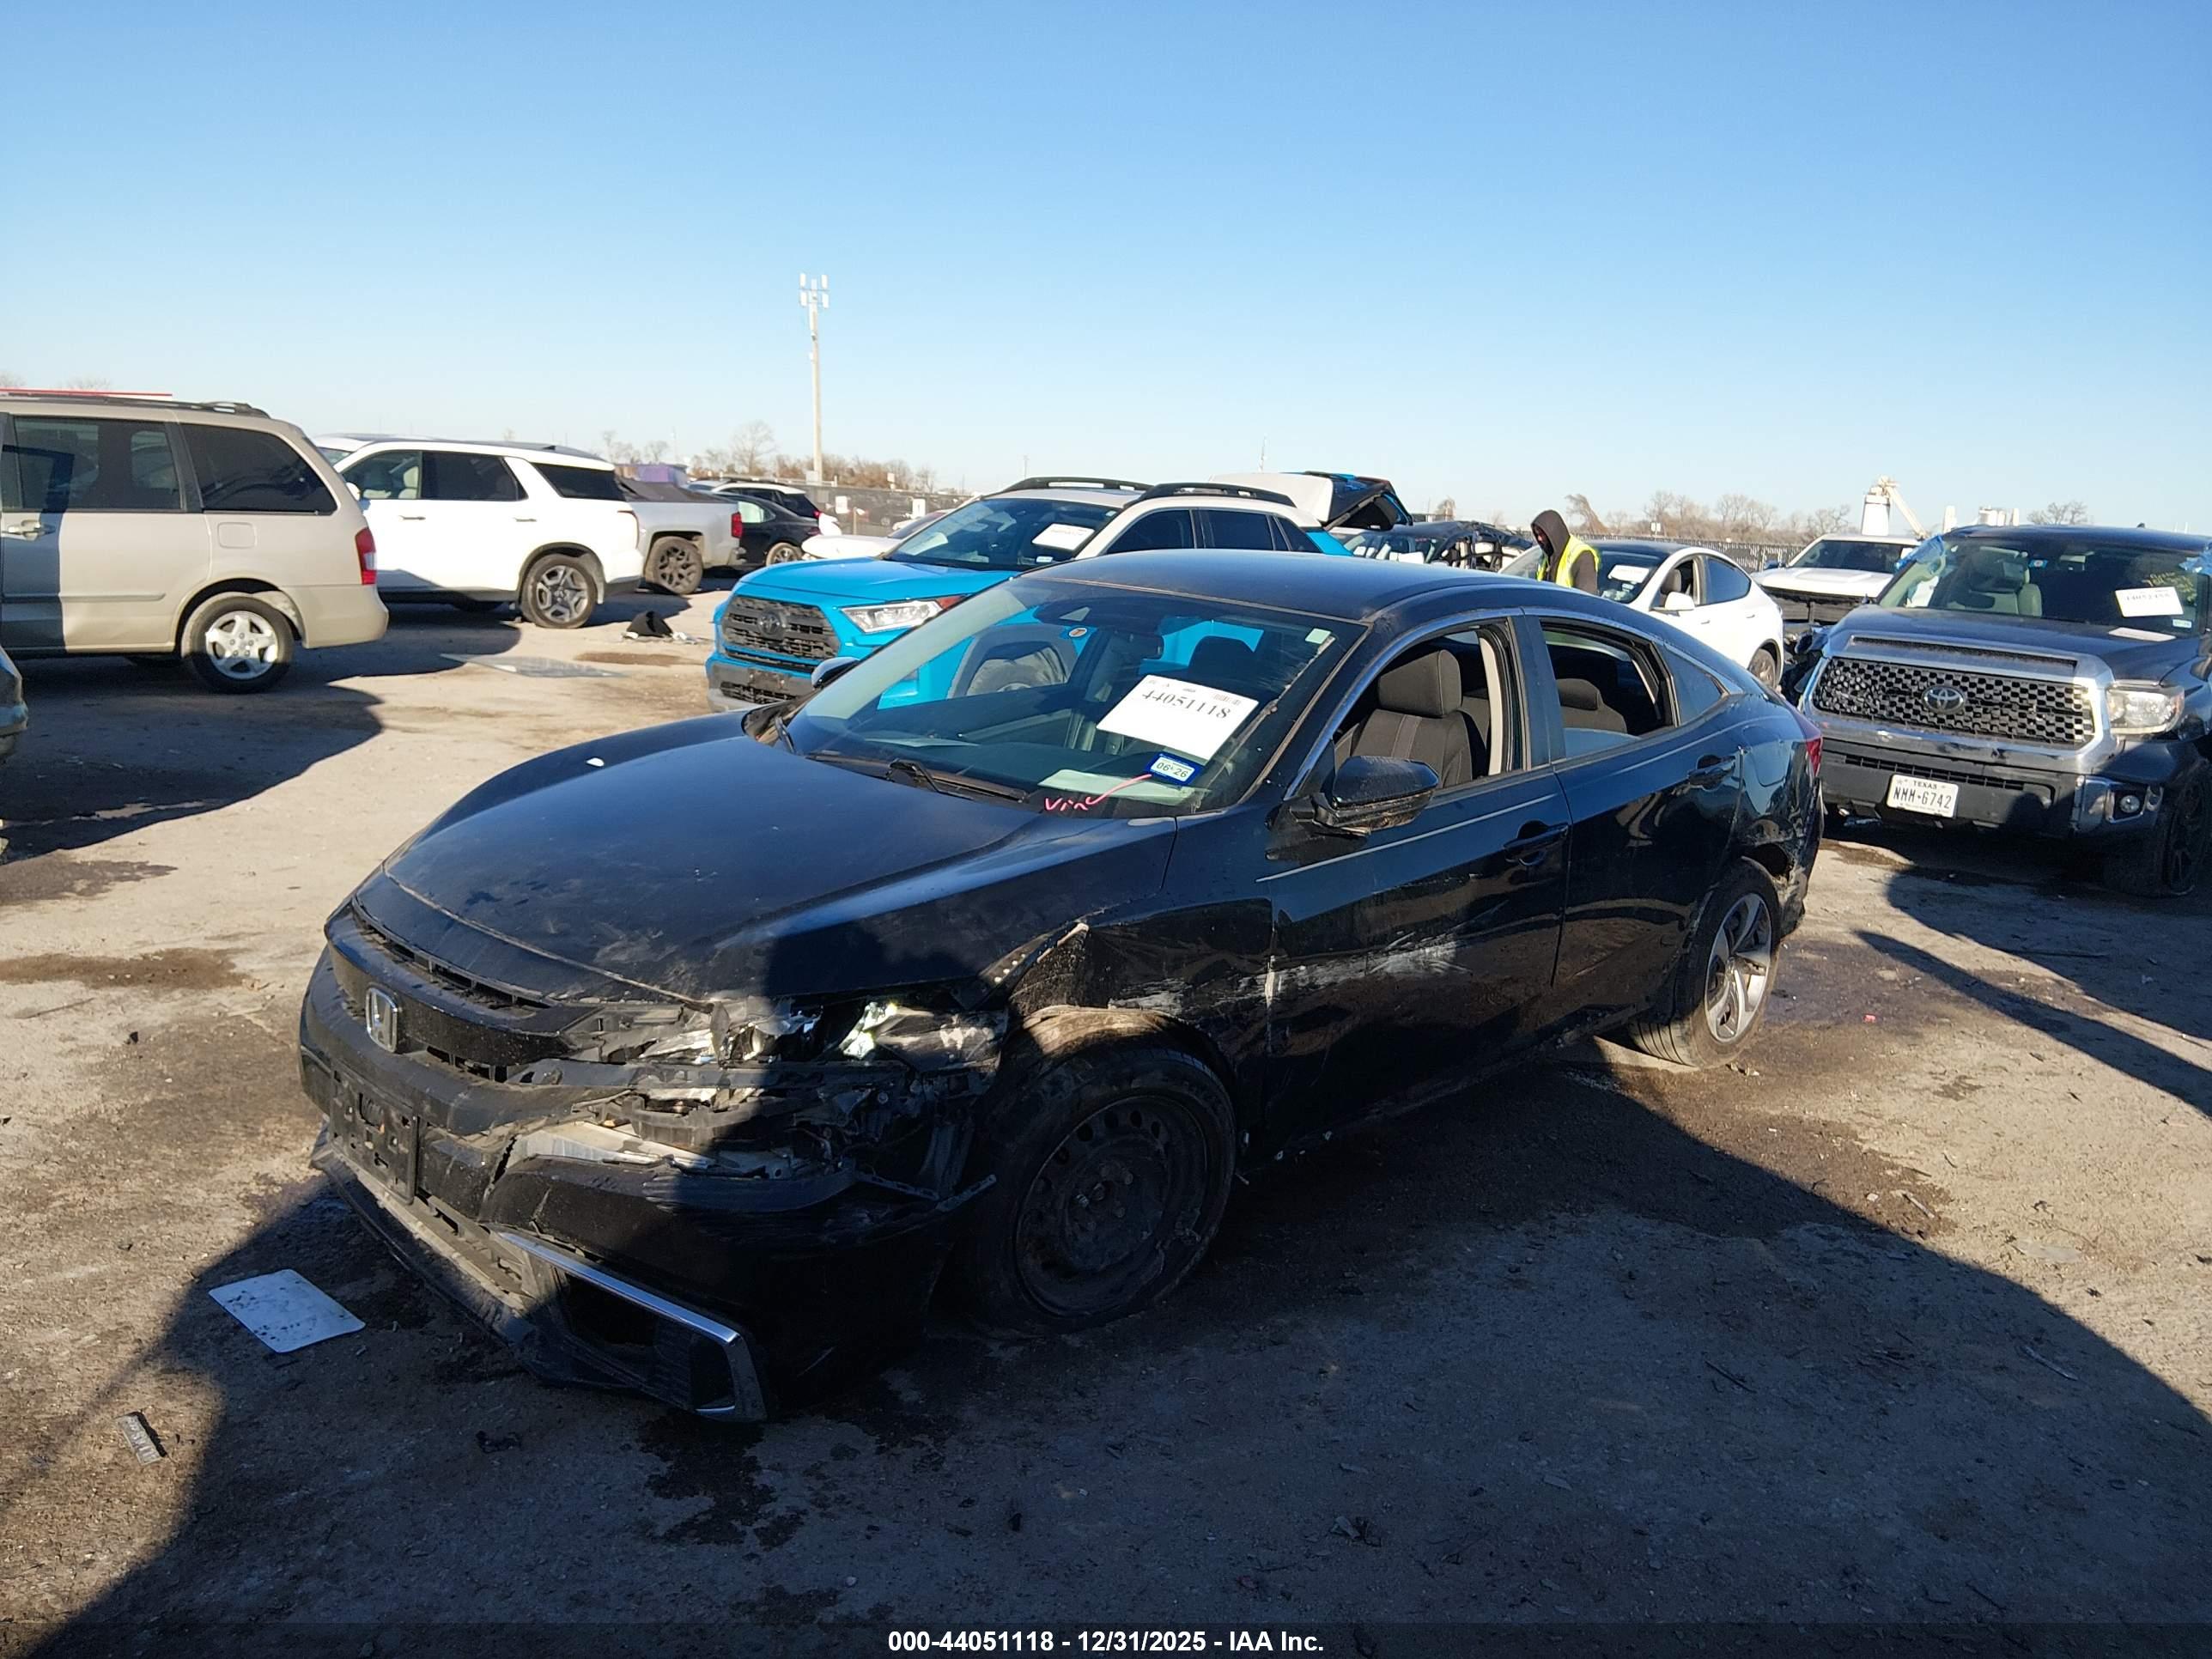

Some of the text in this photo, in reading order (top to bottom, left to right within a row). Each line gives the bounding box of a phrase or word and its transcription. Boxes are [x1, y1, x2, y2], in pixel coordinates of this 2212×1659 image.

[1142, 690, 1232, 719] 44051118
[1156, 762, 1188, 778] 06 26
[1913, 780, 1937, 790] TEXAS
